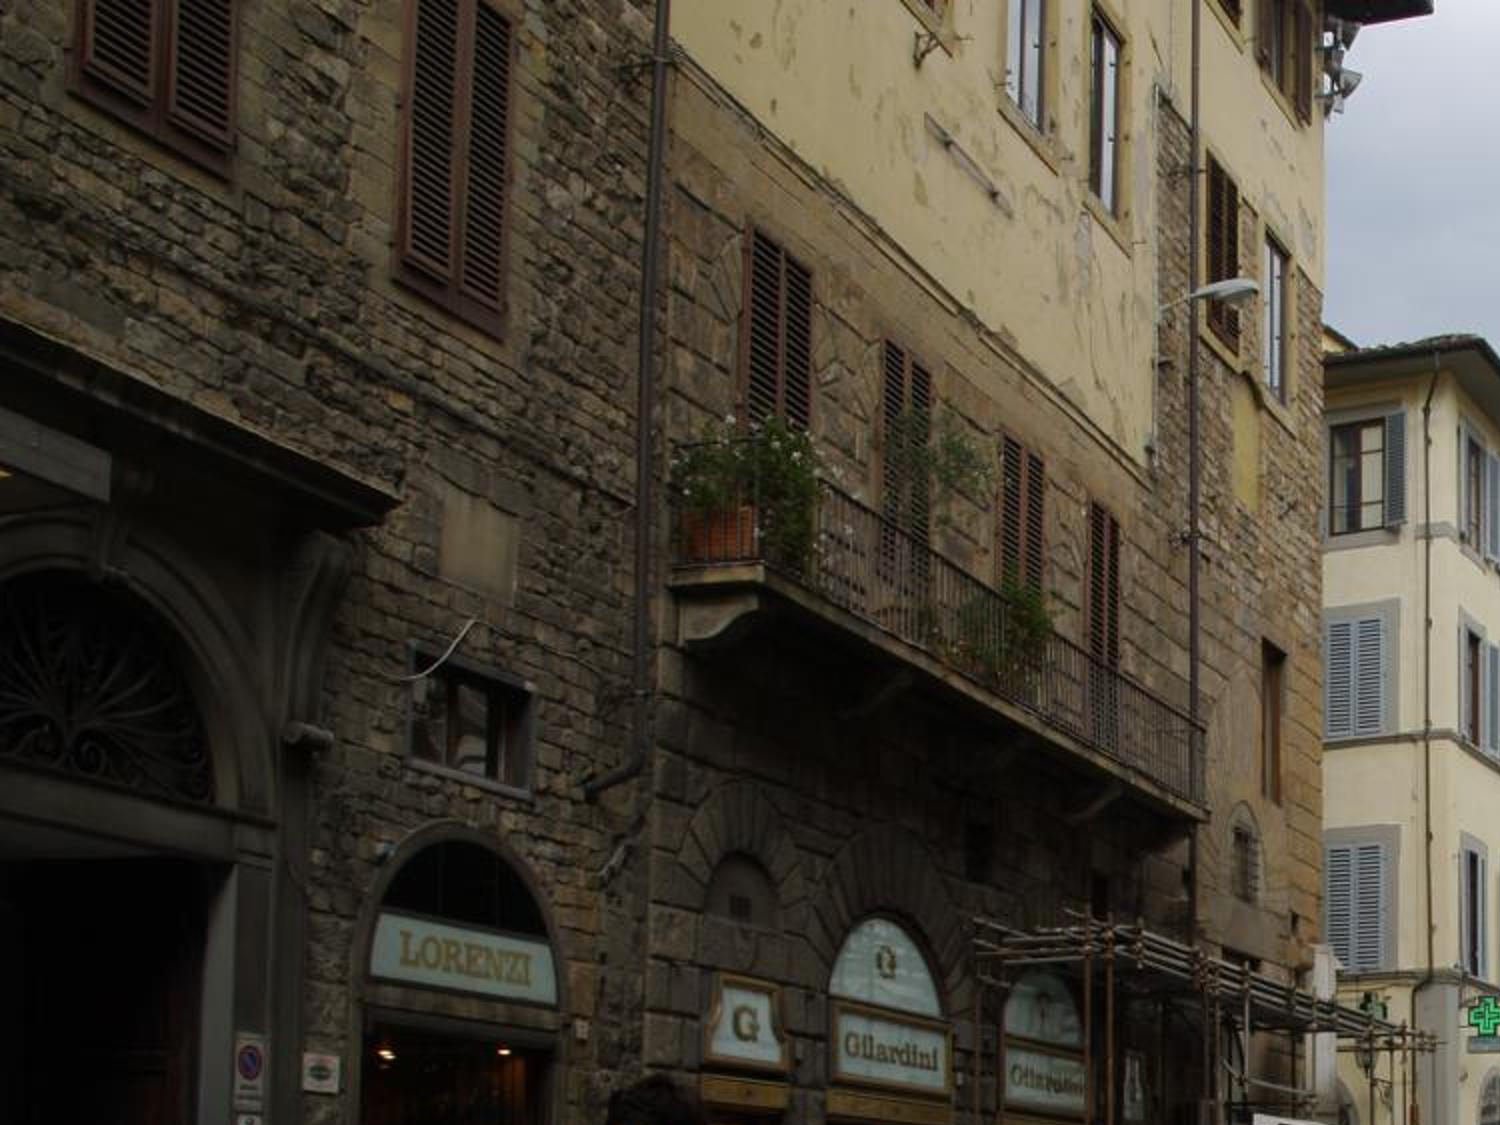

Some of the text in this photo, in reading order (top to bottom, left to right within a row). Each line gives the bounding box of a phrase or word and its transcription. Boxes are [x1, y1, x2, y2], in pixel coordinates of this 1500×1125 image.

[400, 929, 532, 987] LORENZI
[733, 1004, 760, 1043] G
[845, 1033, 939, 1073] Gilardini
